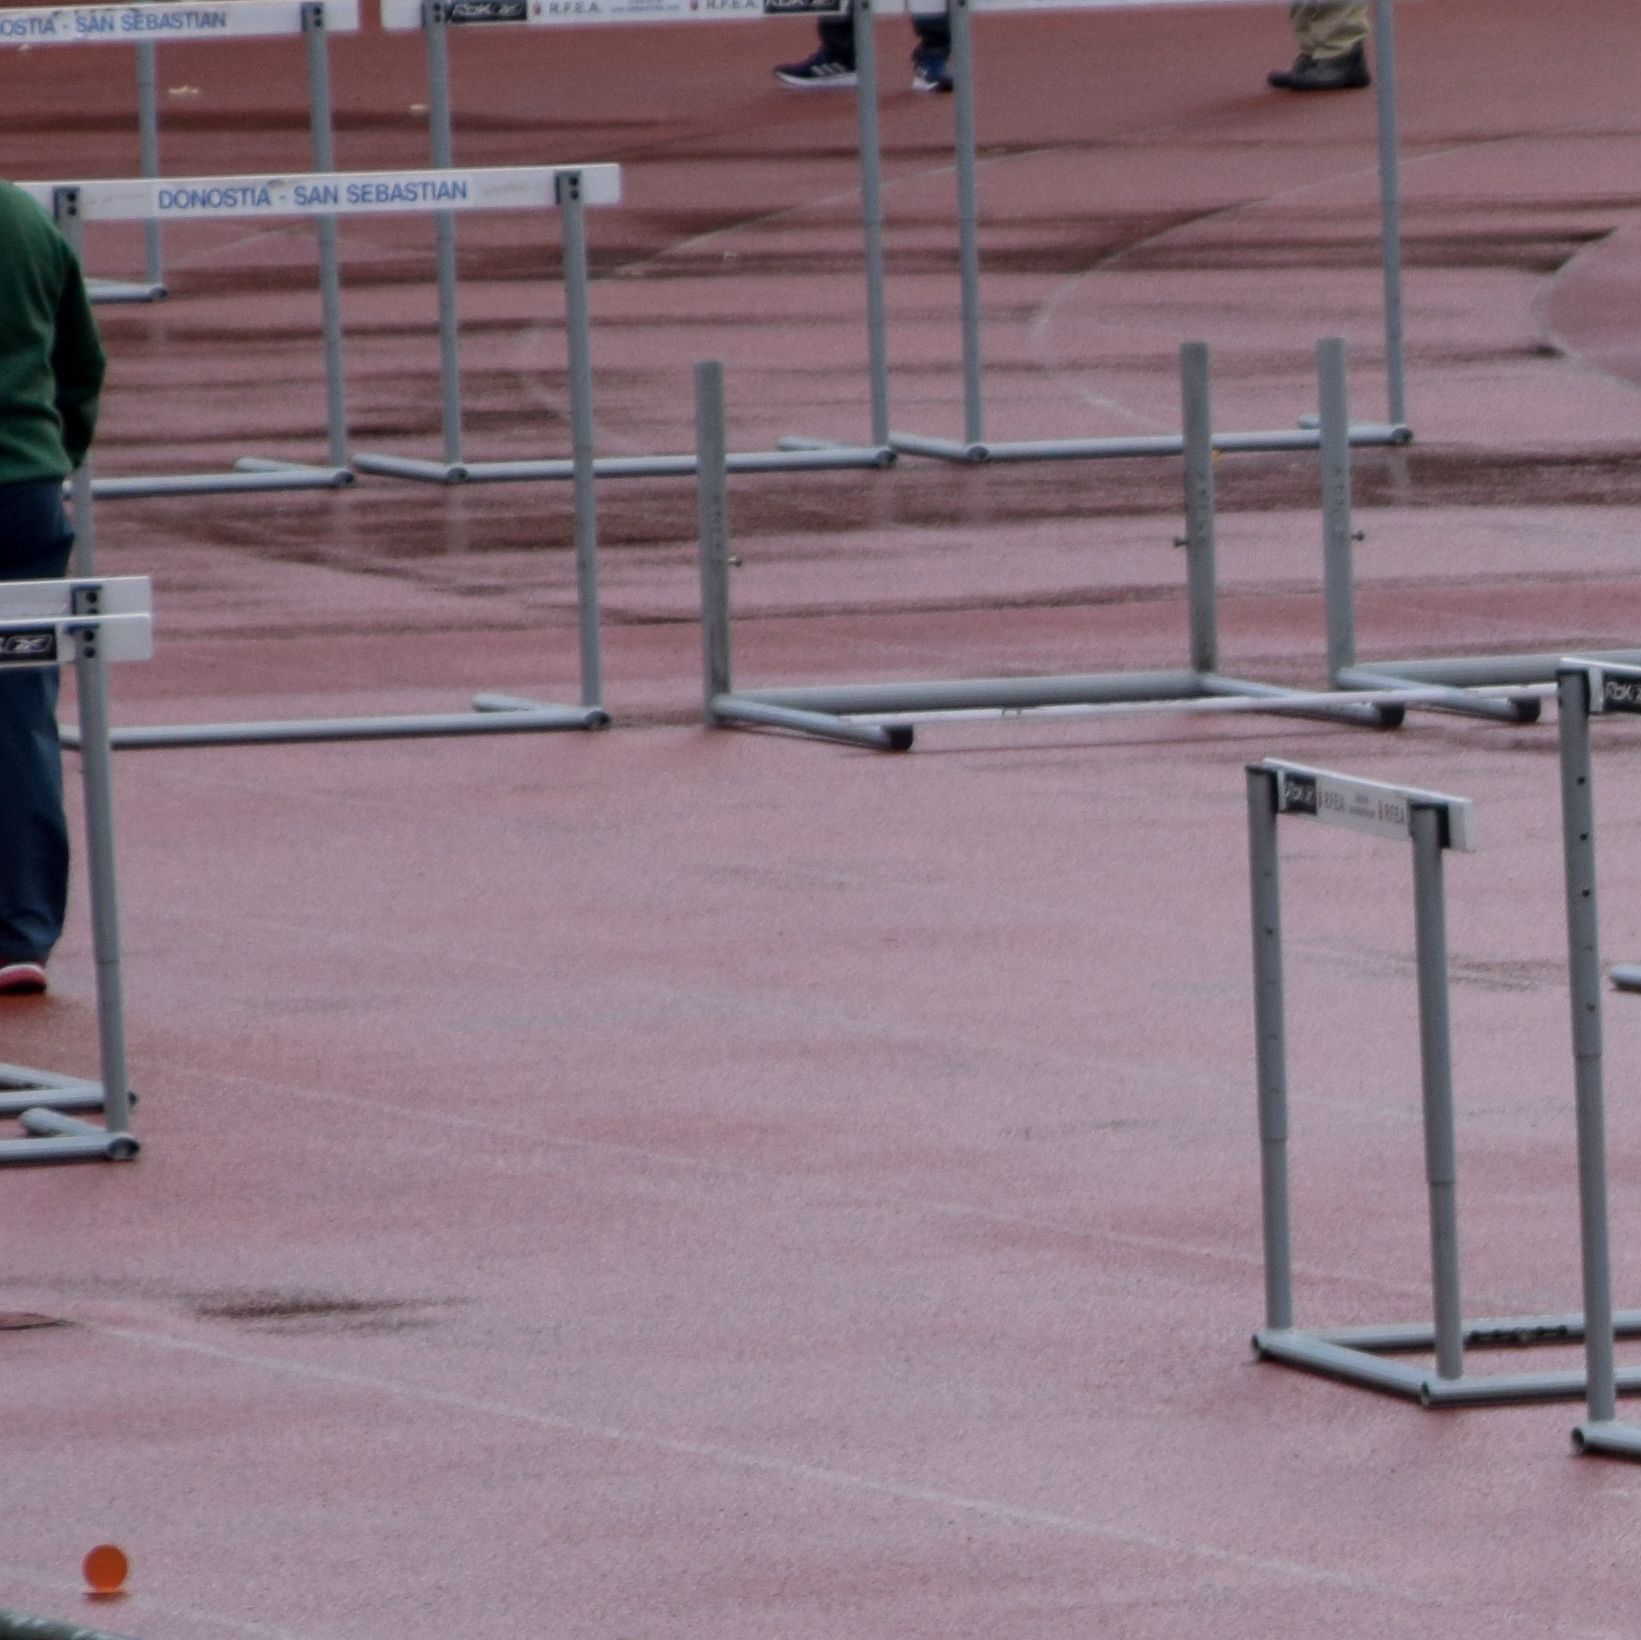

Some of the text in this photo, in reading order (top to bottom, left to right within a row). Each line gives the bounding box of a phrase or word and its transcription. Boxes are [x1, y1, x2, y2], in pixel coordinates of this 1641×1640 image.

[75, 14, 115, 33] SAN
[120, 12, 227, 32] SEBASTIAN
[158, 187, 272, 211] DONOSTIA
[293, 185, 339, 206] SAN
[346, 180, 469, 204] SEBASTIAN
